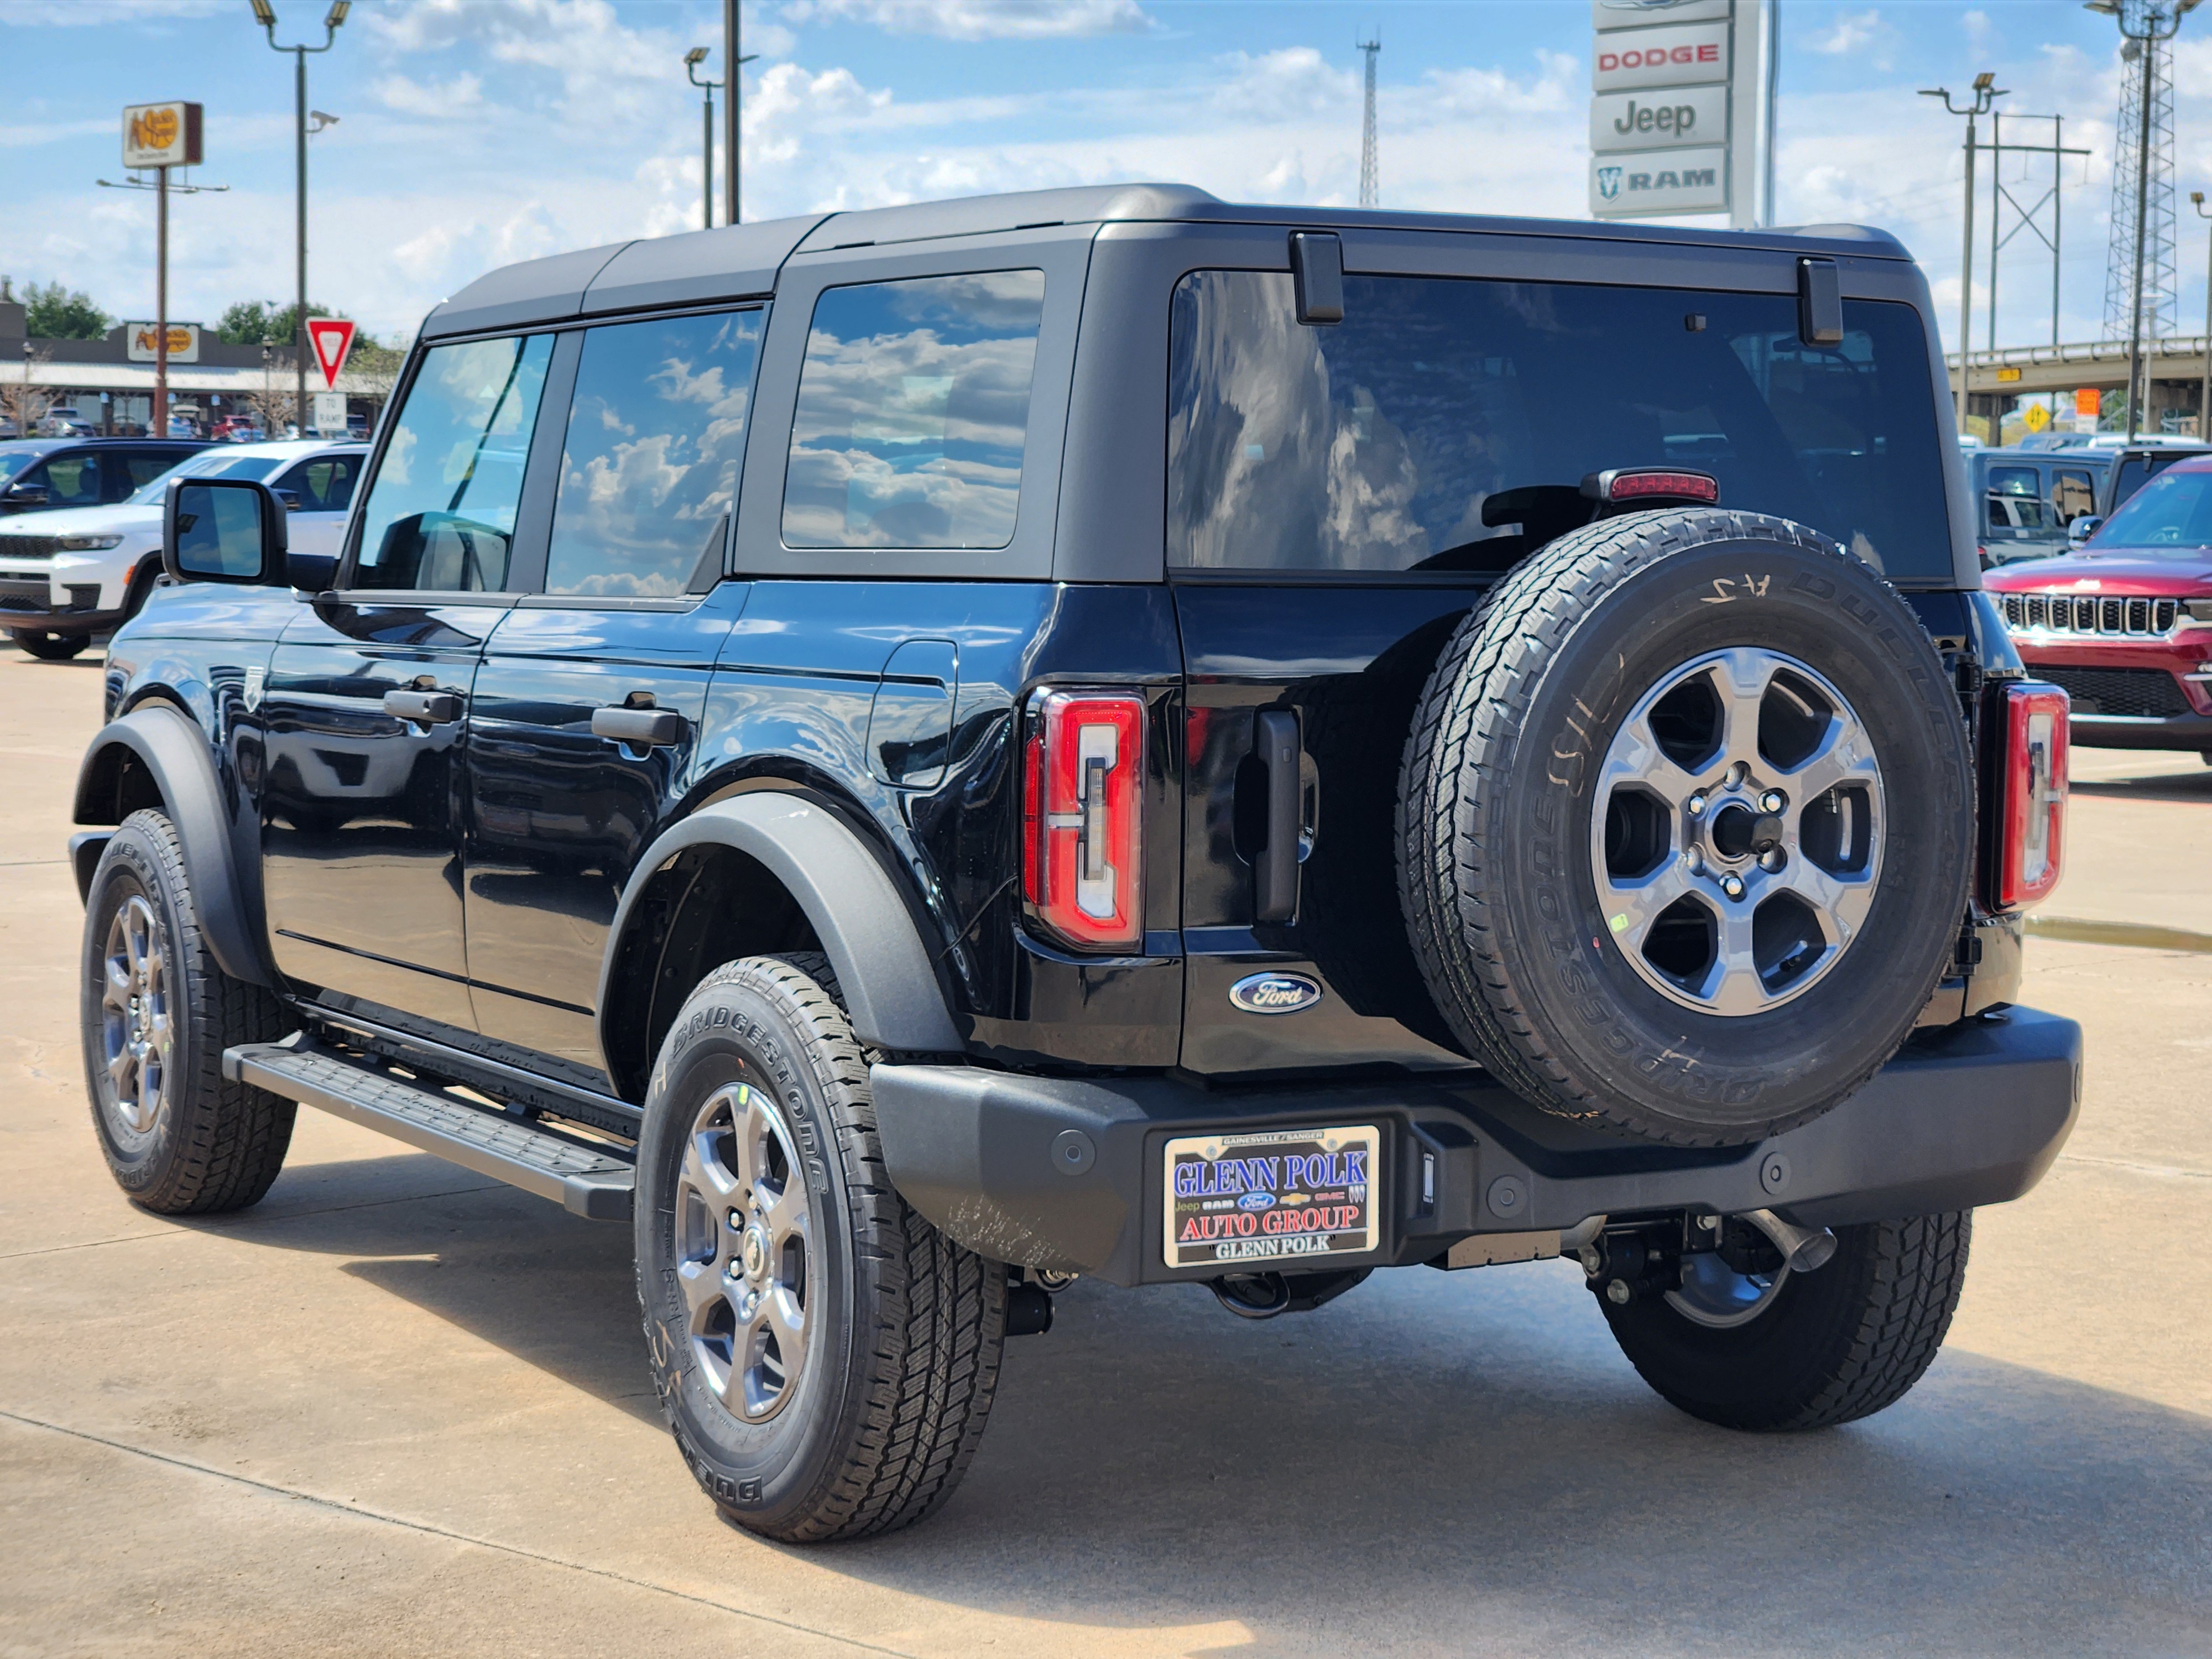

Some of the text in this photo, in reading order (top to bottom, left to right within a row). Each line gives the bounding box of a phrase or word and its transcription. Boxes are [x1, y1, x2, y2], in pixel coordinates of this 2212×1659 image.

[1599, 44, 1719, 72] DODGE
[1614, 100, 1697, 138] Jeep
[1628, 168, 1715, 191] RAM
[1253, 980, 1303, 1006] Ford
[672, 1004, 830, 1194] BRIDGESTONE
[1174, 1151, 1368, 1198] GLENN POLK
[1175, 1201, 1200, 1213] Jeep
[1244, 1194, 1269, 1208] Ford
[1179, 1205, 1360, 1241] AUTO GROUP
